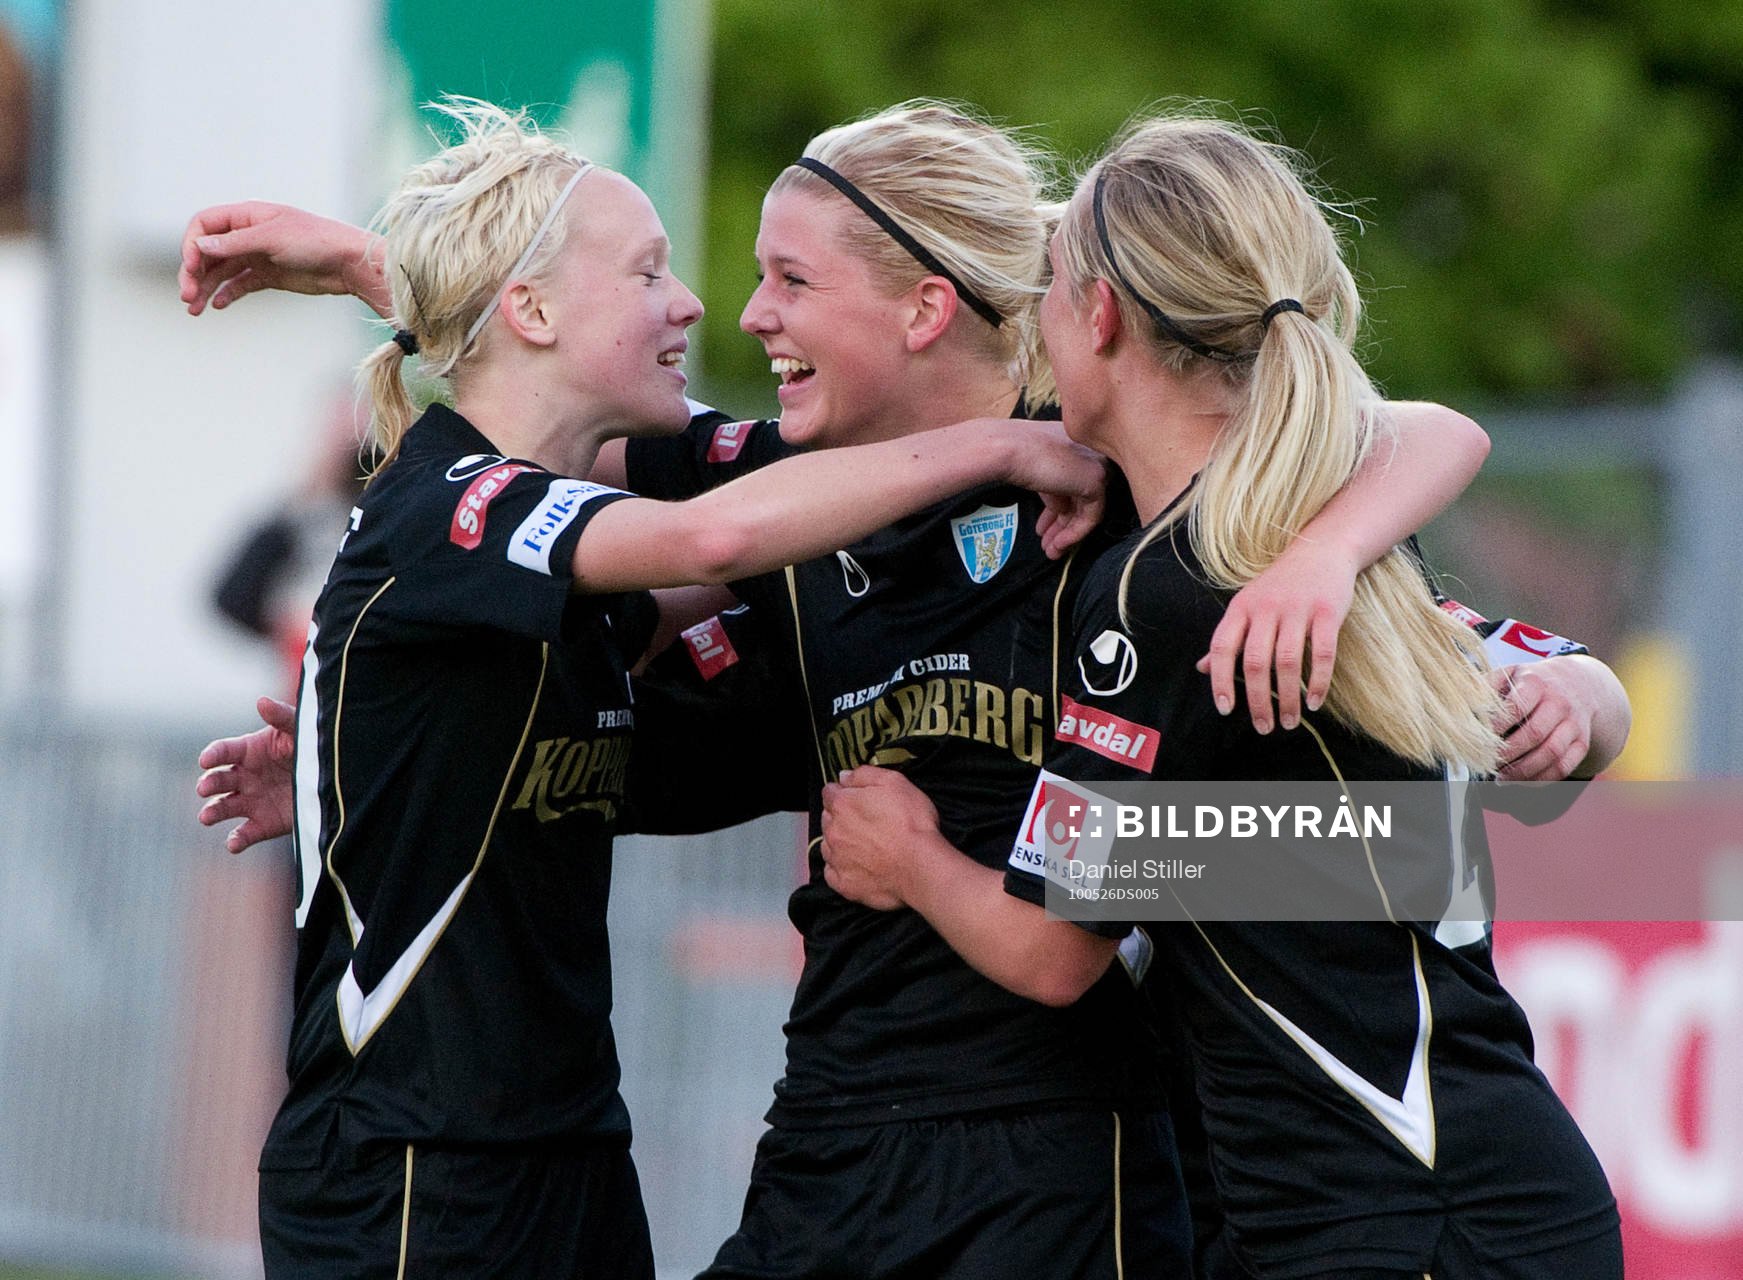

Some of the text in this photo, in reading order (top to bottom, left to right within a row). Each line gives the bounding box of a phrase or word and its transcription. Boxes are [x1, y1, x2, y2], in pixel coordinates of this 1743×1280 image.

[523, 484, 610, 553] FolkSa
[909, 653, 971, 677] CIDER
[1013, 846, 1058, 875] ENSKA
